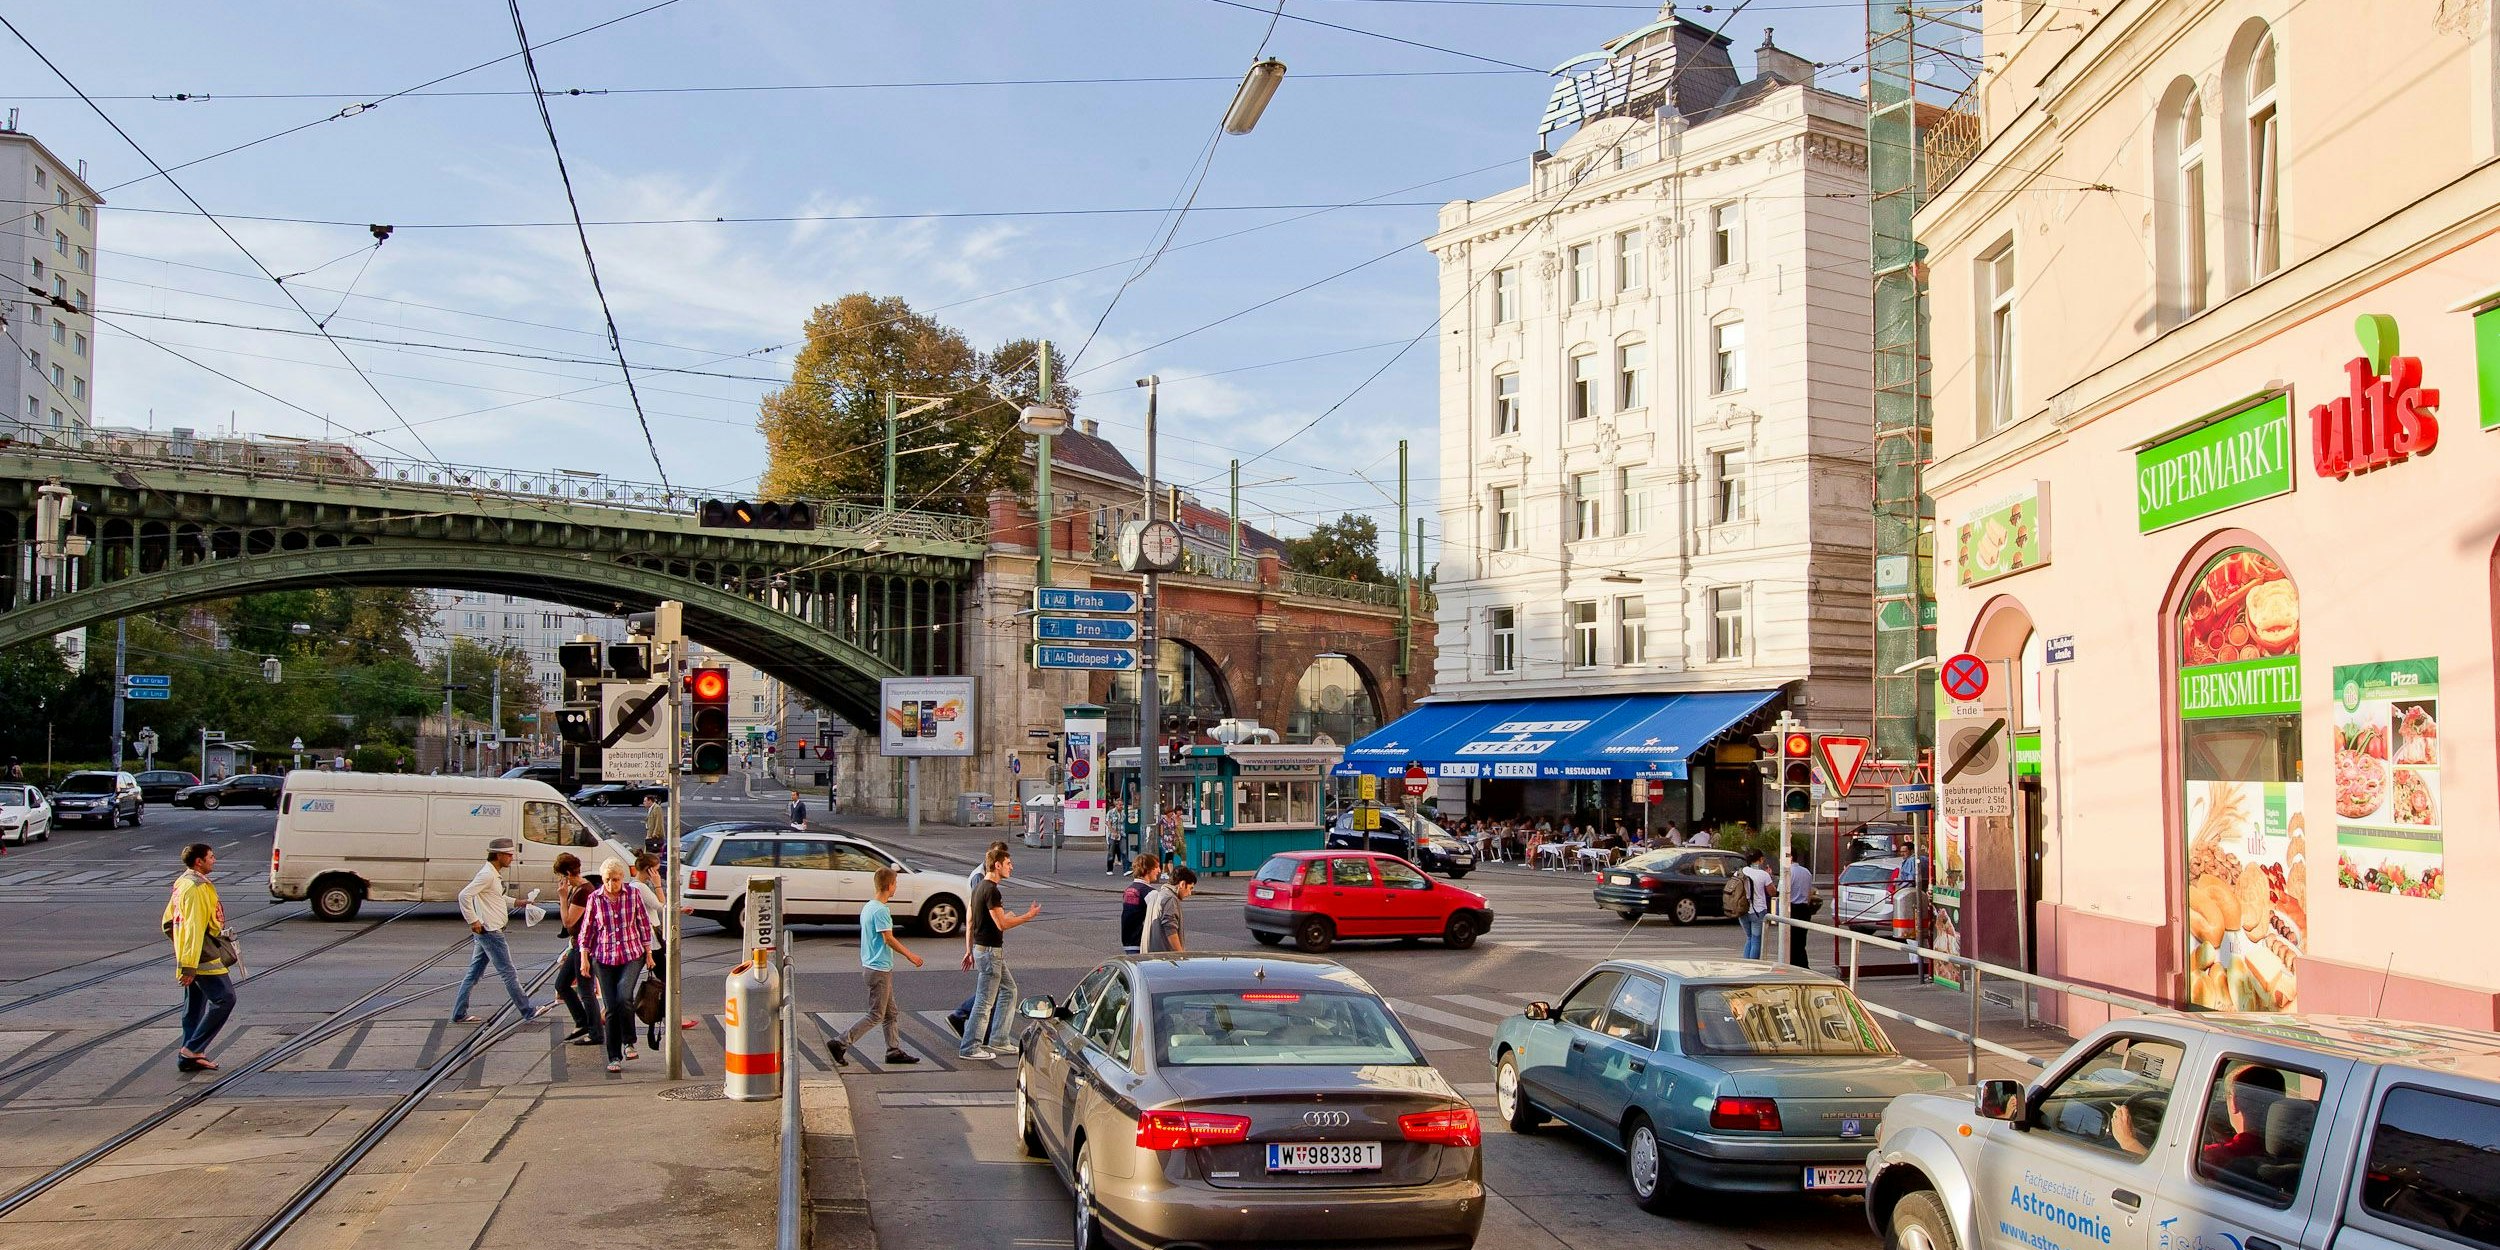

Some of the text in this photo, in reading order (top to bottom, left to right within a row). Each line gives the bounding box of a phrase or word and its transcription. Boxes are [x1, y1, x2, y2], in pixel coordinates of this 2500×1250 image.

[2309, 314, 2440, 478] uli's
[2140, 416, 2287, 515] SUPERMARKT
[1054, 594, 1104, 606] A22 Praha
[1050, 623, 1101, 634] 7 Brno
[1055, 652, 1109, 665] A4 Budapest
[2390, 671, 2418, 686] Pizza
[2183, 665, 2302, 710] LEBENSMITTEL
[1956, 706, 1978, 715] Ende
[1501, 722, 1581, 731] BLAU
[1466, 743, 1545, 752] STERN
[609, 752, 664, 760] gebührenpflichtig
[609, 760, 662, 769] Parkdauer: 2 Std.
[1443, 765, 1535, 775] BLAU STERN
[1544, 767, 1559, 775] BAR
[1565, 767, 1611, 775] RESTAURANT
[1944, 786, 2007, 796] gebührenpflichtig
[1898, 792, 1930, 805] EINBAHN
[1946, 796, 2007, 804] Parkdauer: 2 Std.
[1282, 1147, 1294, 1164] W
[1309, 1147, 1362, 1164] 98338
[1366, 1146, 1375, 1163] T
[1817, 1170, 1828, 1185] W
[1838, 1170, 1867, 1185] 222
[2024, 1170, 2095, 1206] Fachgeschäft für
[2010, 1185, 2112, 1244] Astronomie
